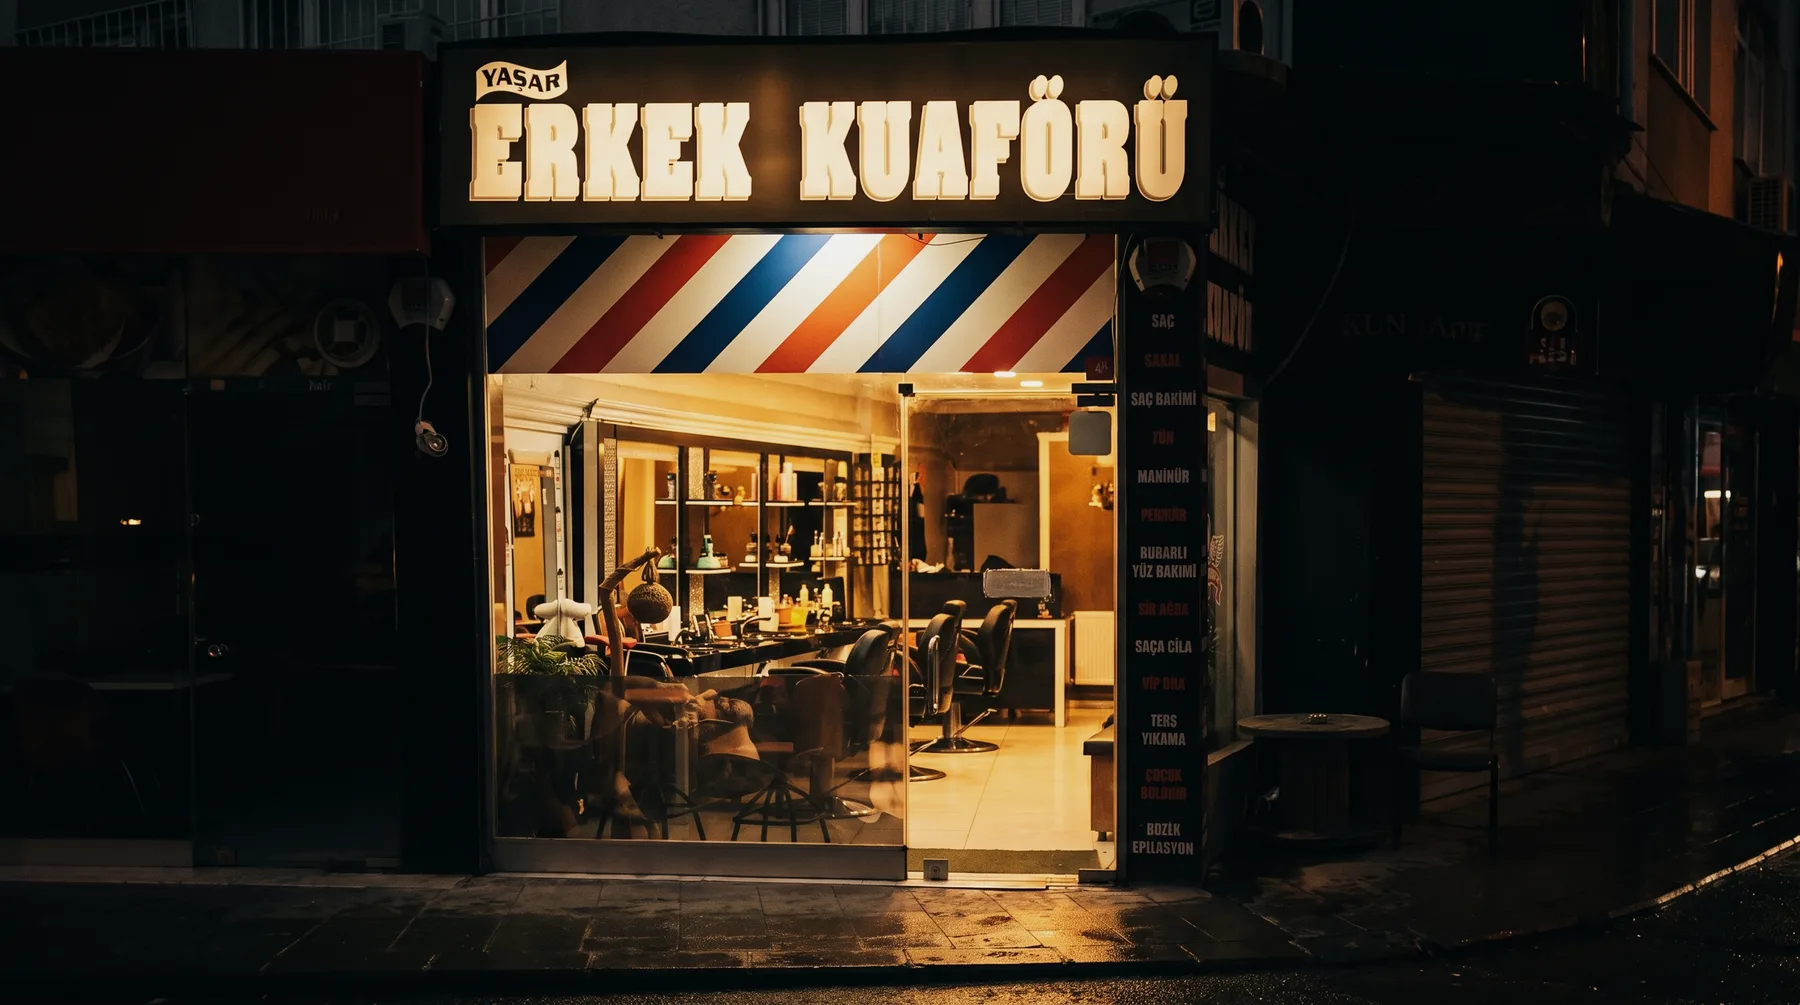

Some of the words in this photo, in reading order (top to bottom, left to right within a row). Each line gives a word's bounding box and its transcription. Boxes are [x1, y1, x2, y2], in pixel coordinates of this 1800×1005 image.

[481, 67, 560, 92] YAŞAR
[469, 102, 752, 201] ERKEK
[798, 74, 1188, 203] KUAFÖRÜ
[1151, 313, 1175, 330] SAÇ
[1131, 391, 1153, 408] SAÇ
[1132, 562, 1153, 578] YÜZ
[1135, 639, 1165, 656] SAÇA
[1167, 637, 1193, 654] CİLA
[1141, 732, 1186, 746] YIKAMA
